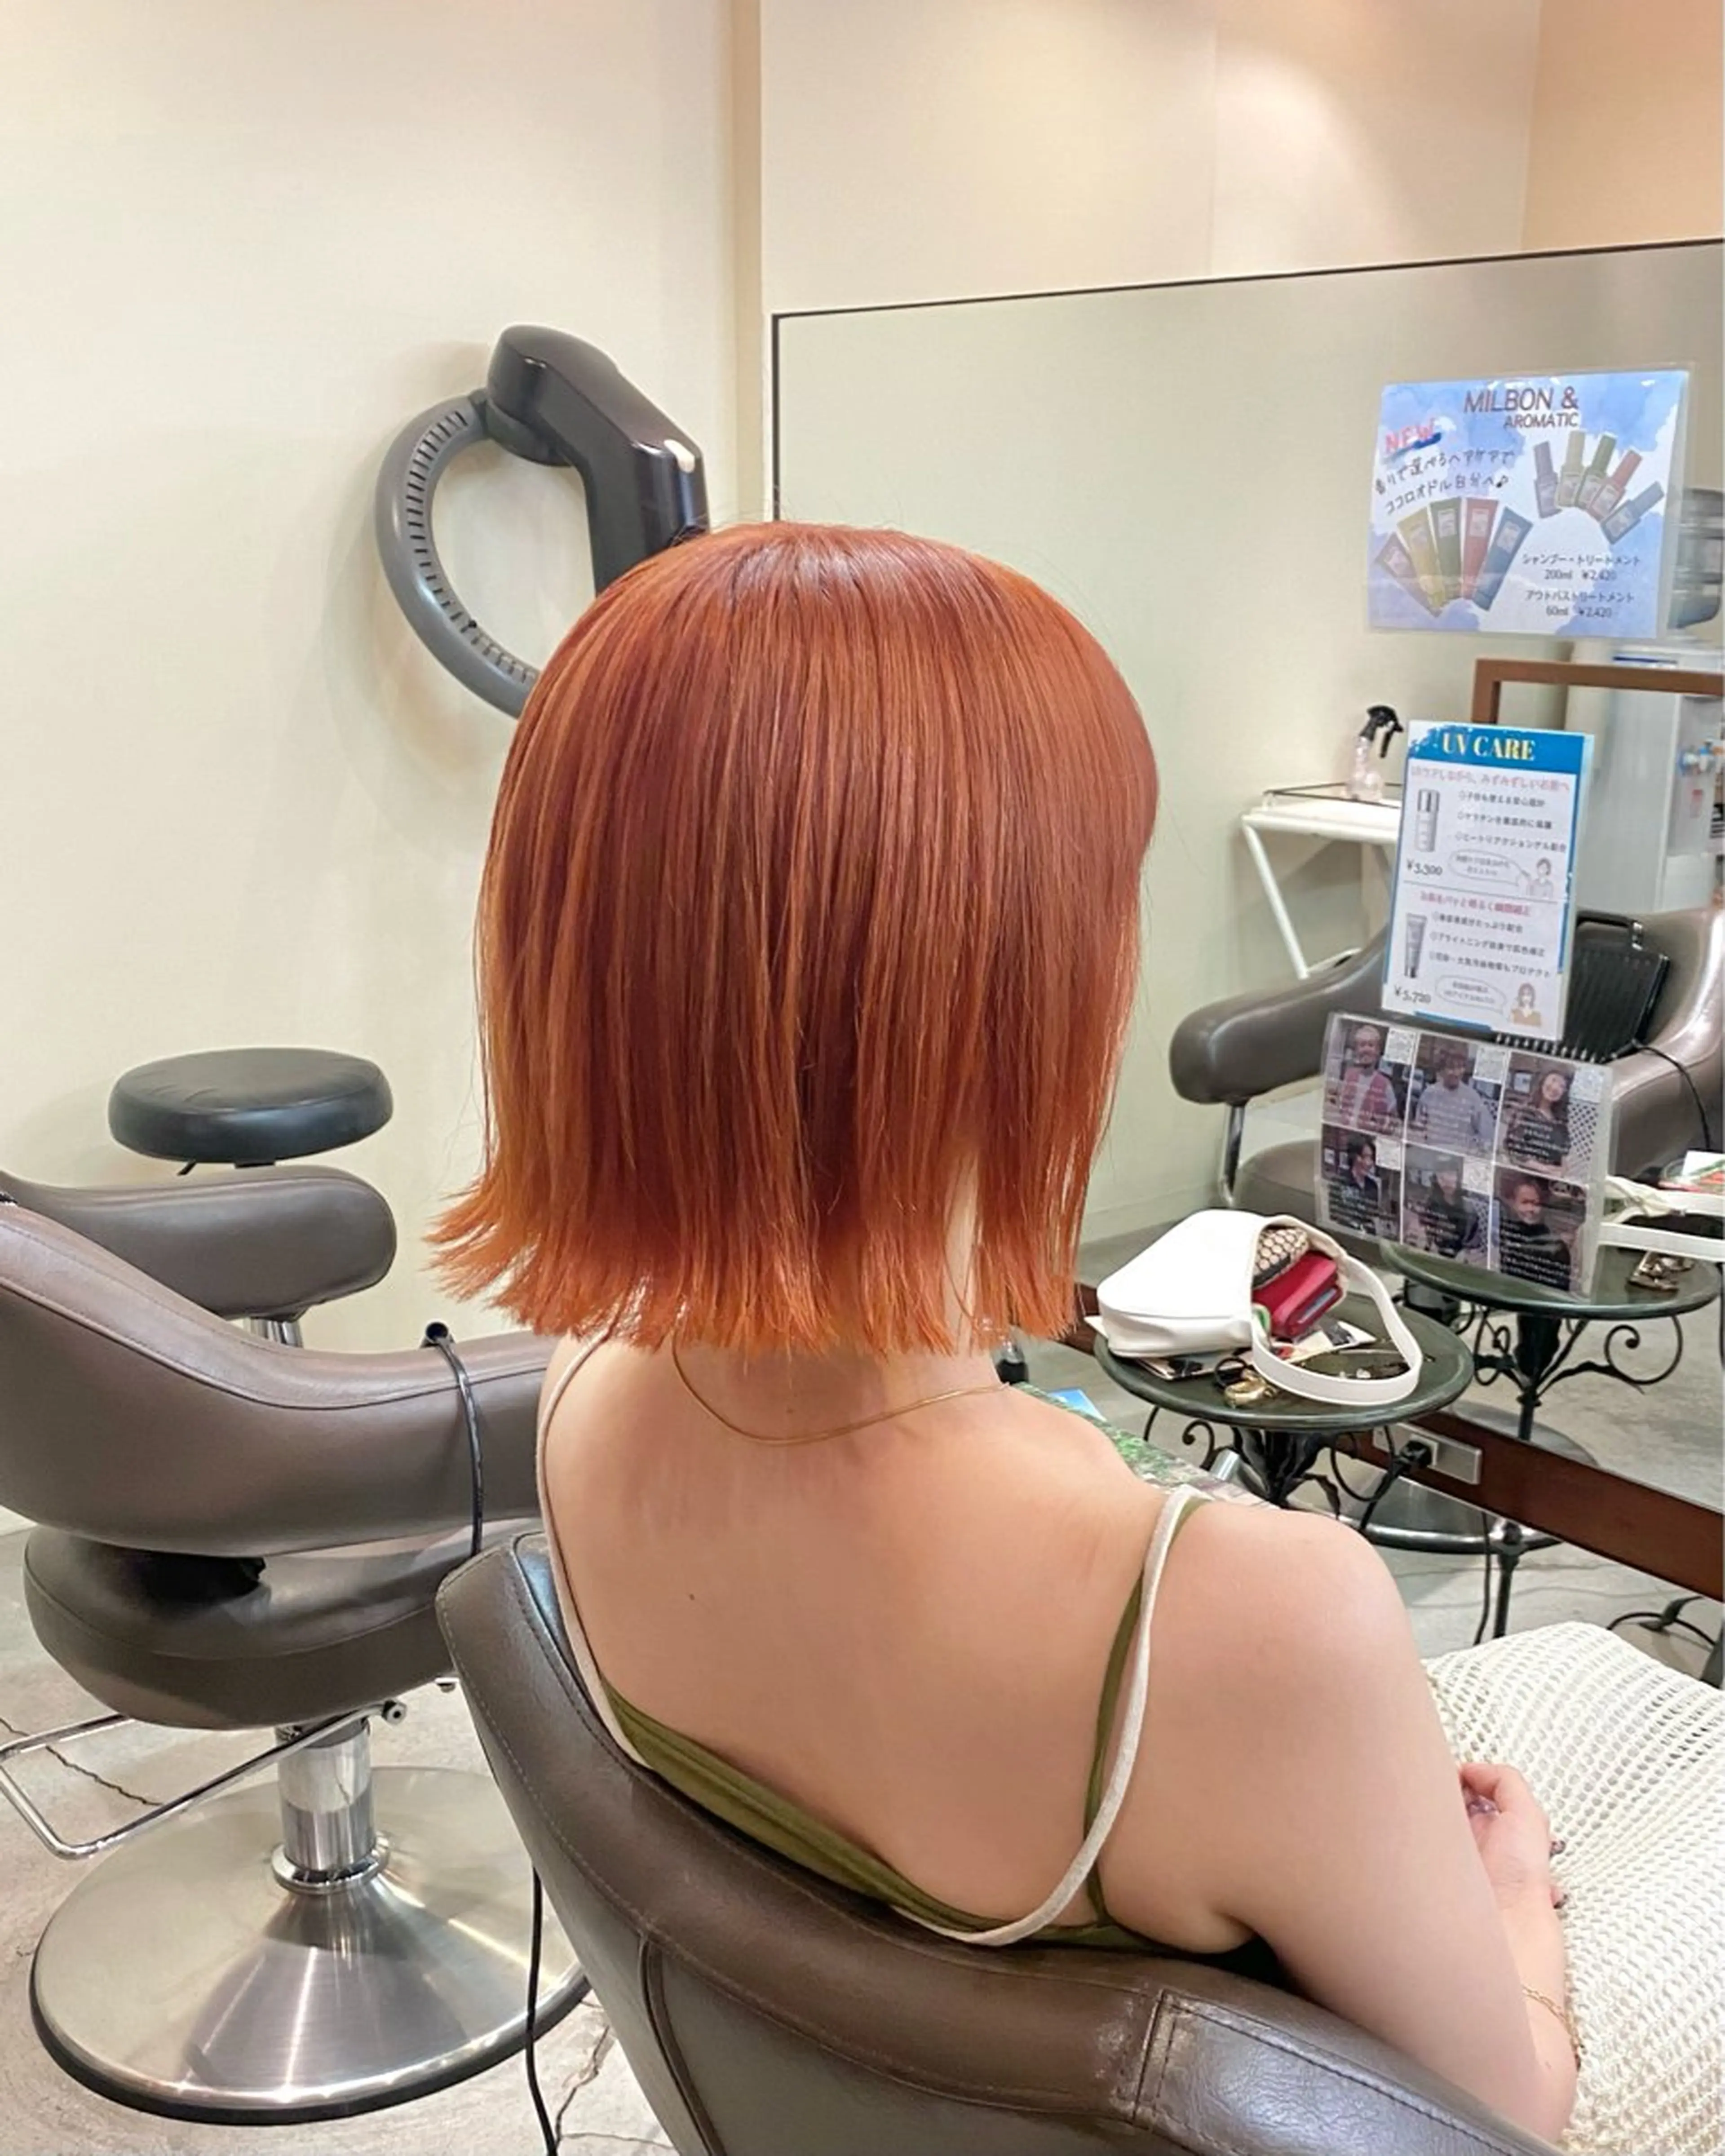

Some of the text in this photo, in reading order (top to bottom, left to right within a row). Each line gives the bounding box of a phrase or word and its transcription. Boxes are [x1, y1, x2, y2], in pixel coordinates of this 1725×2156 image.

[1464, 386, 1579, 413] MILBON &
[1503, 412, 1579, 429] AROMATIC
[1385, 417, 1436, 454] NEW
[1443, 733, 1536, 761] UV CARE
